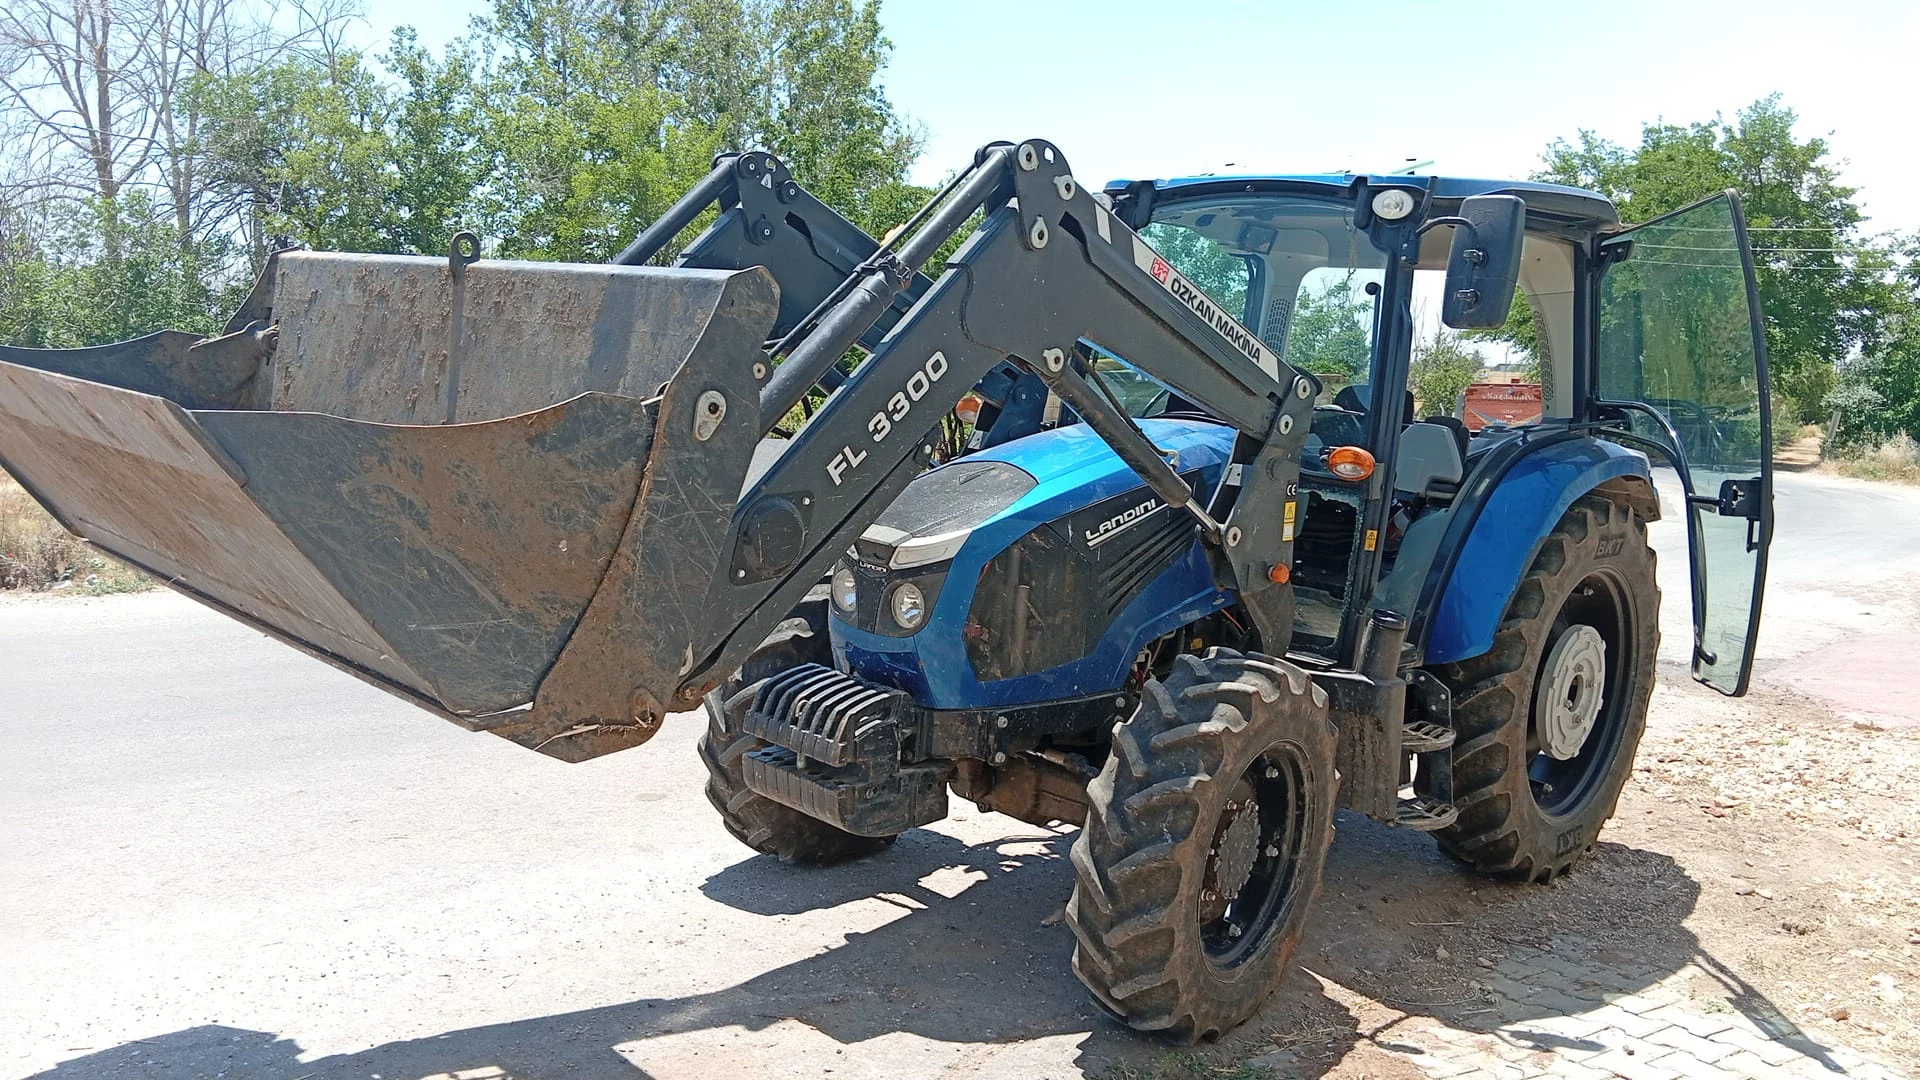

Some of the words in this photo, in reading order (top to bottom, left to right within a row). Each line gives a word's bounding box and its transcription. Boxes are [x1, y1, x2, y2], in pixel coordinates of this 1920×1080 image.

[1170, 275, 1215, 326] ÖZKAN
[1216, 314, 1261, 364] MAKİNA
[826, 445, 868, 486] FL
[868, 351, 948, 442] 3300
[1286, 484, 1297, 496] CE
[1596, 537, 1625, 558] BKT
